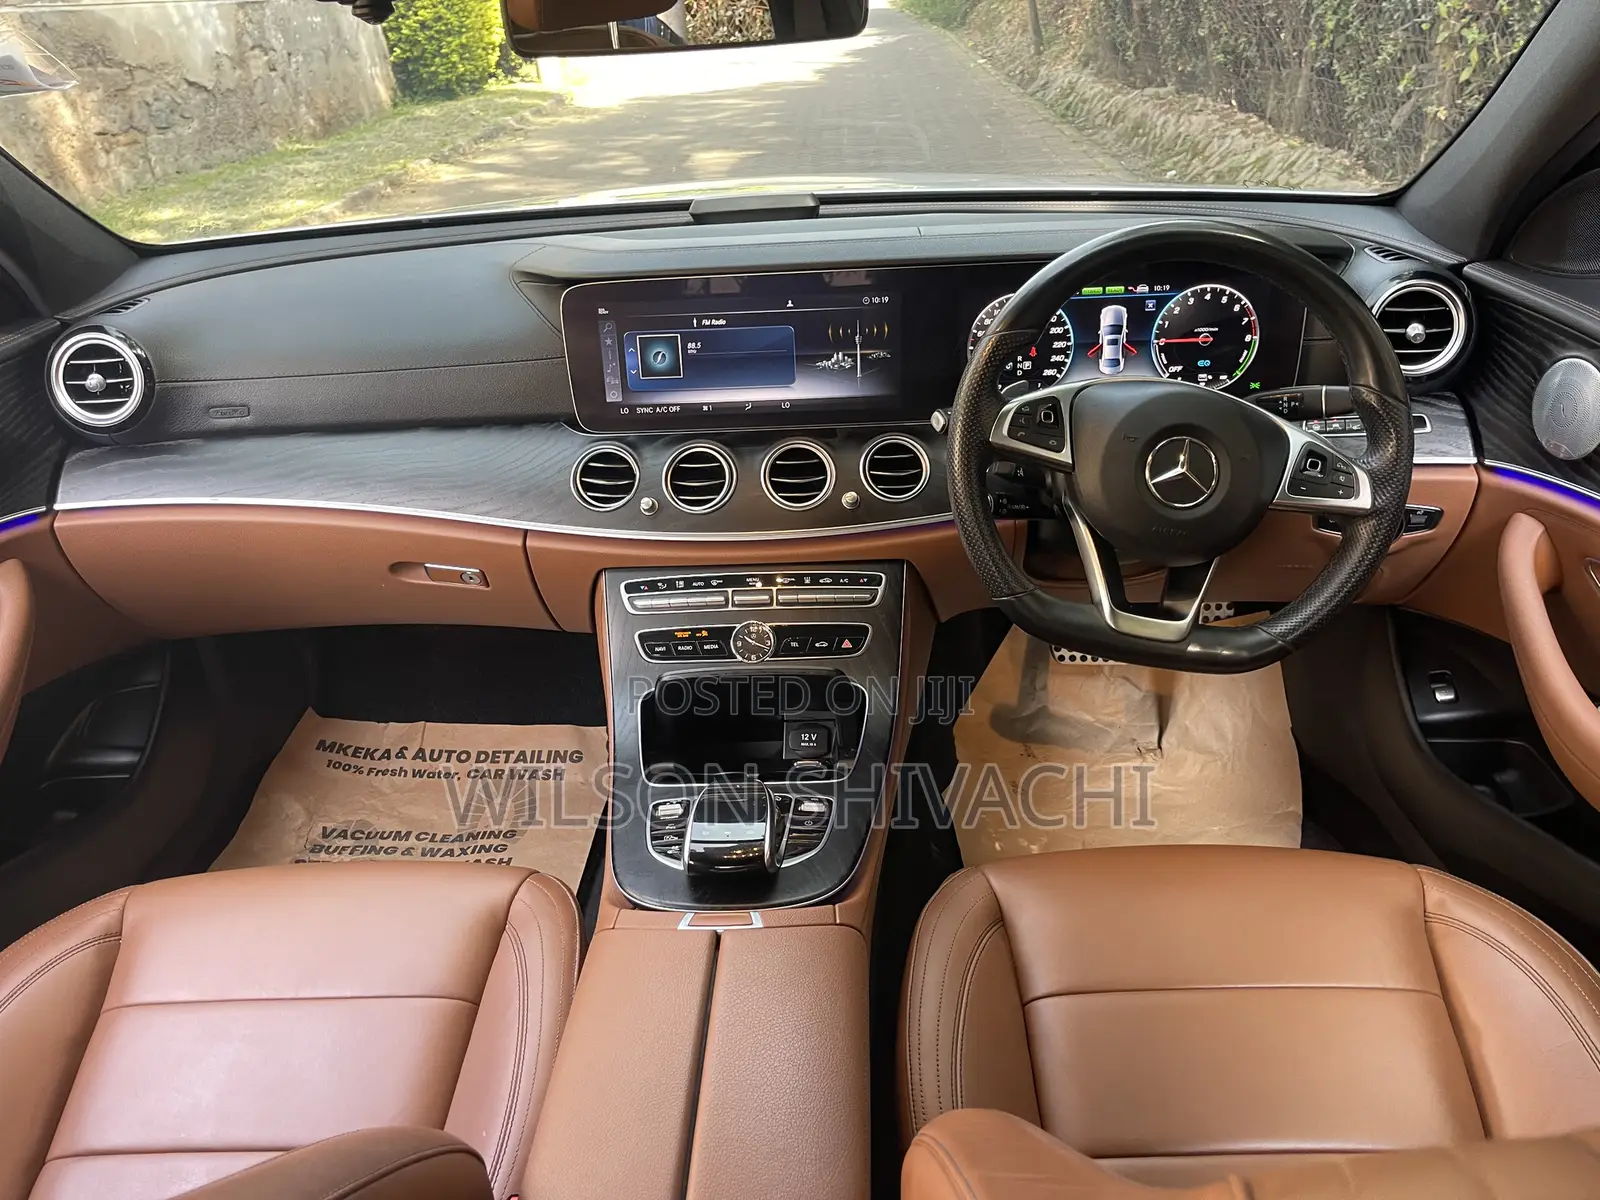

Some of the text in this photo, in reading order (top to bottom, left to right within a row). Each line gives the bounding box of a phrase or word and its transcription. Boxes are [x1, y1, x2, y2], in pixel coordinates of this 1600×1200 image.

[872, 296, 889, 305] 10:19
[316, 739, 584, 764] MKEKA & AUTO DETAILING
[326, 759, 565, 781] 100% Fresh Water, CAR WASH
[321, 826, 518, 843] VACUUM CLEANING
[310, 844, 509, 857] BUFFING & WAXING
